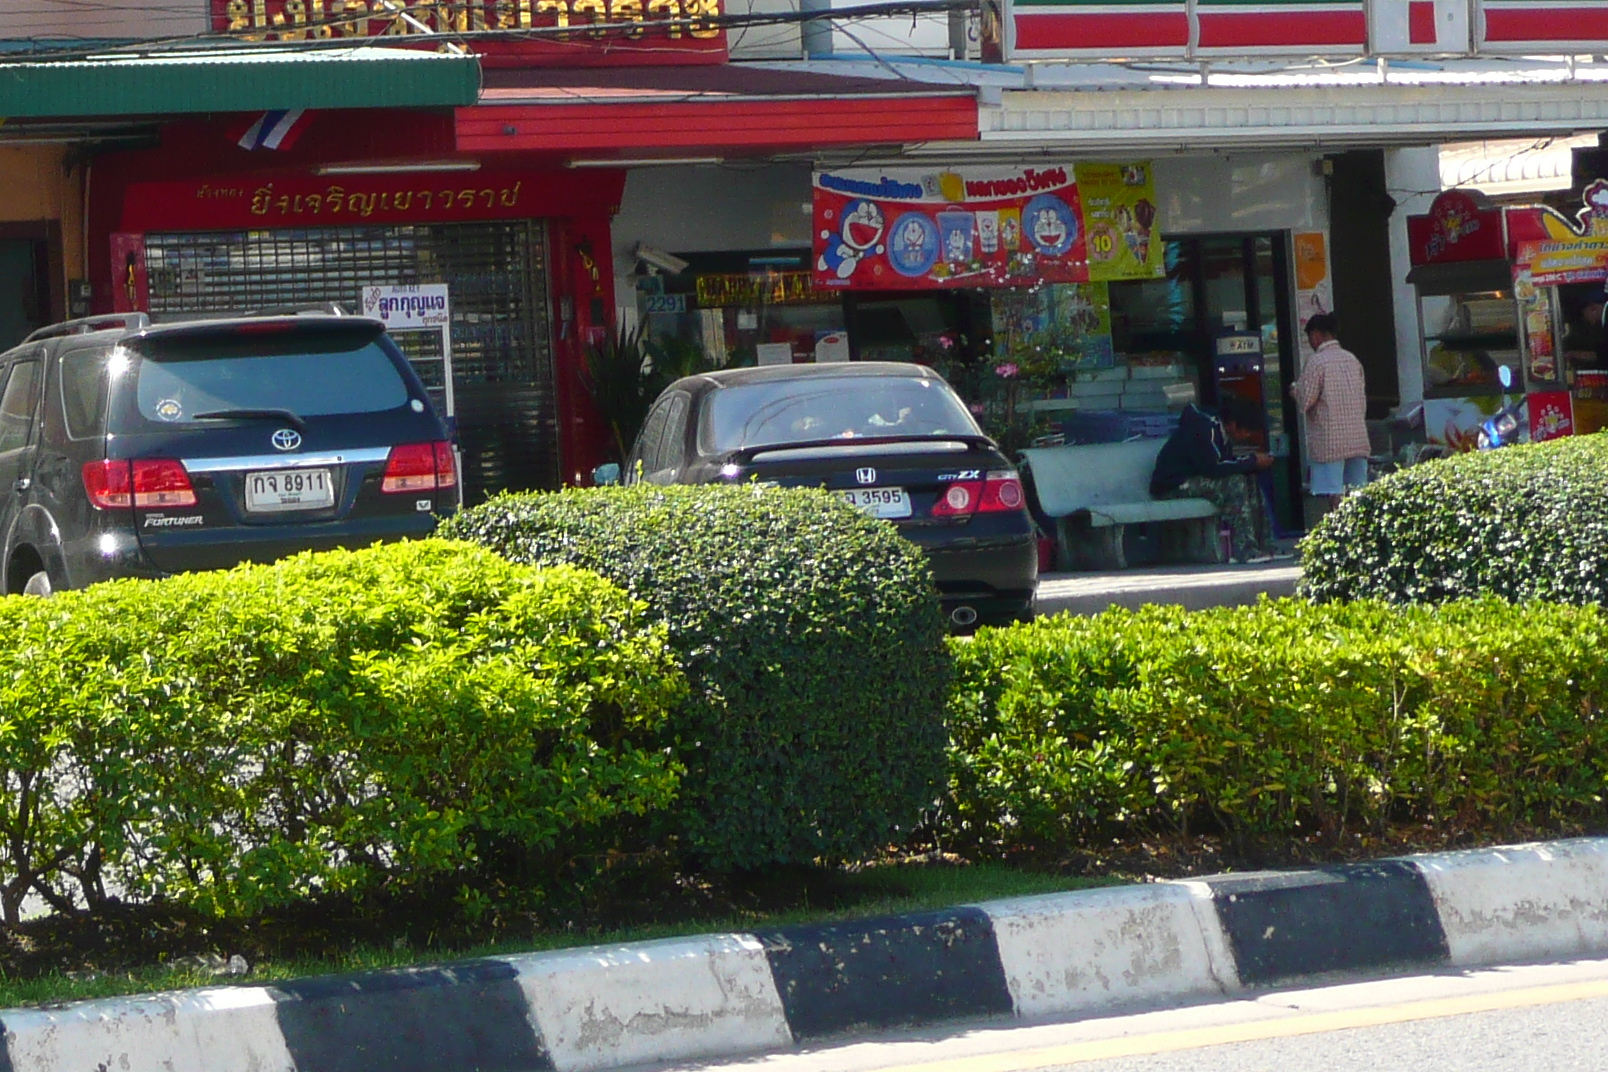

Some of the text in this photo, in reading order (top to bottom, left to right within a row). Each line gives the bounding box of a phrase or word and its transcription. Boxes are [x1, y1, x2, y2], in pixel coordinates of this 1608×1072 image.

[1092, 234, 1112, 253] 10
[379, 295, 445, 319] ลูกกุญแจ
[647, 295, 685, 312] 2291
[253, 473, 323, 494] กจ 8911
[957, 470, 980, 480] ZX
[862, 490, 902, 505] 3595
[144, 515, 204, 528] FORTUNER
